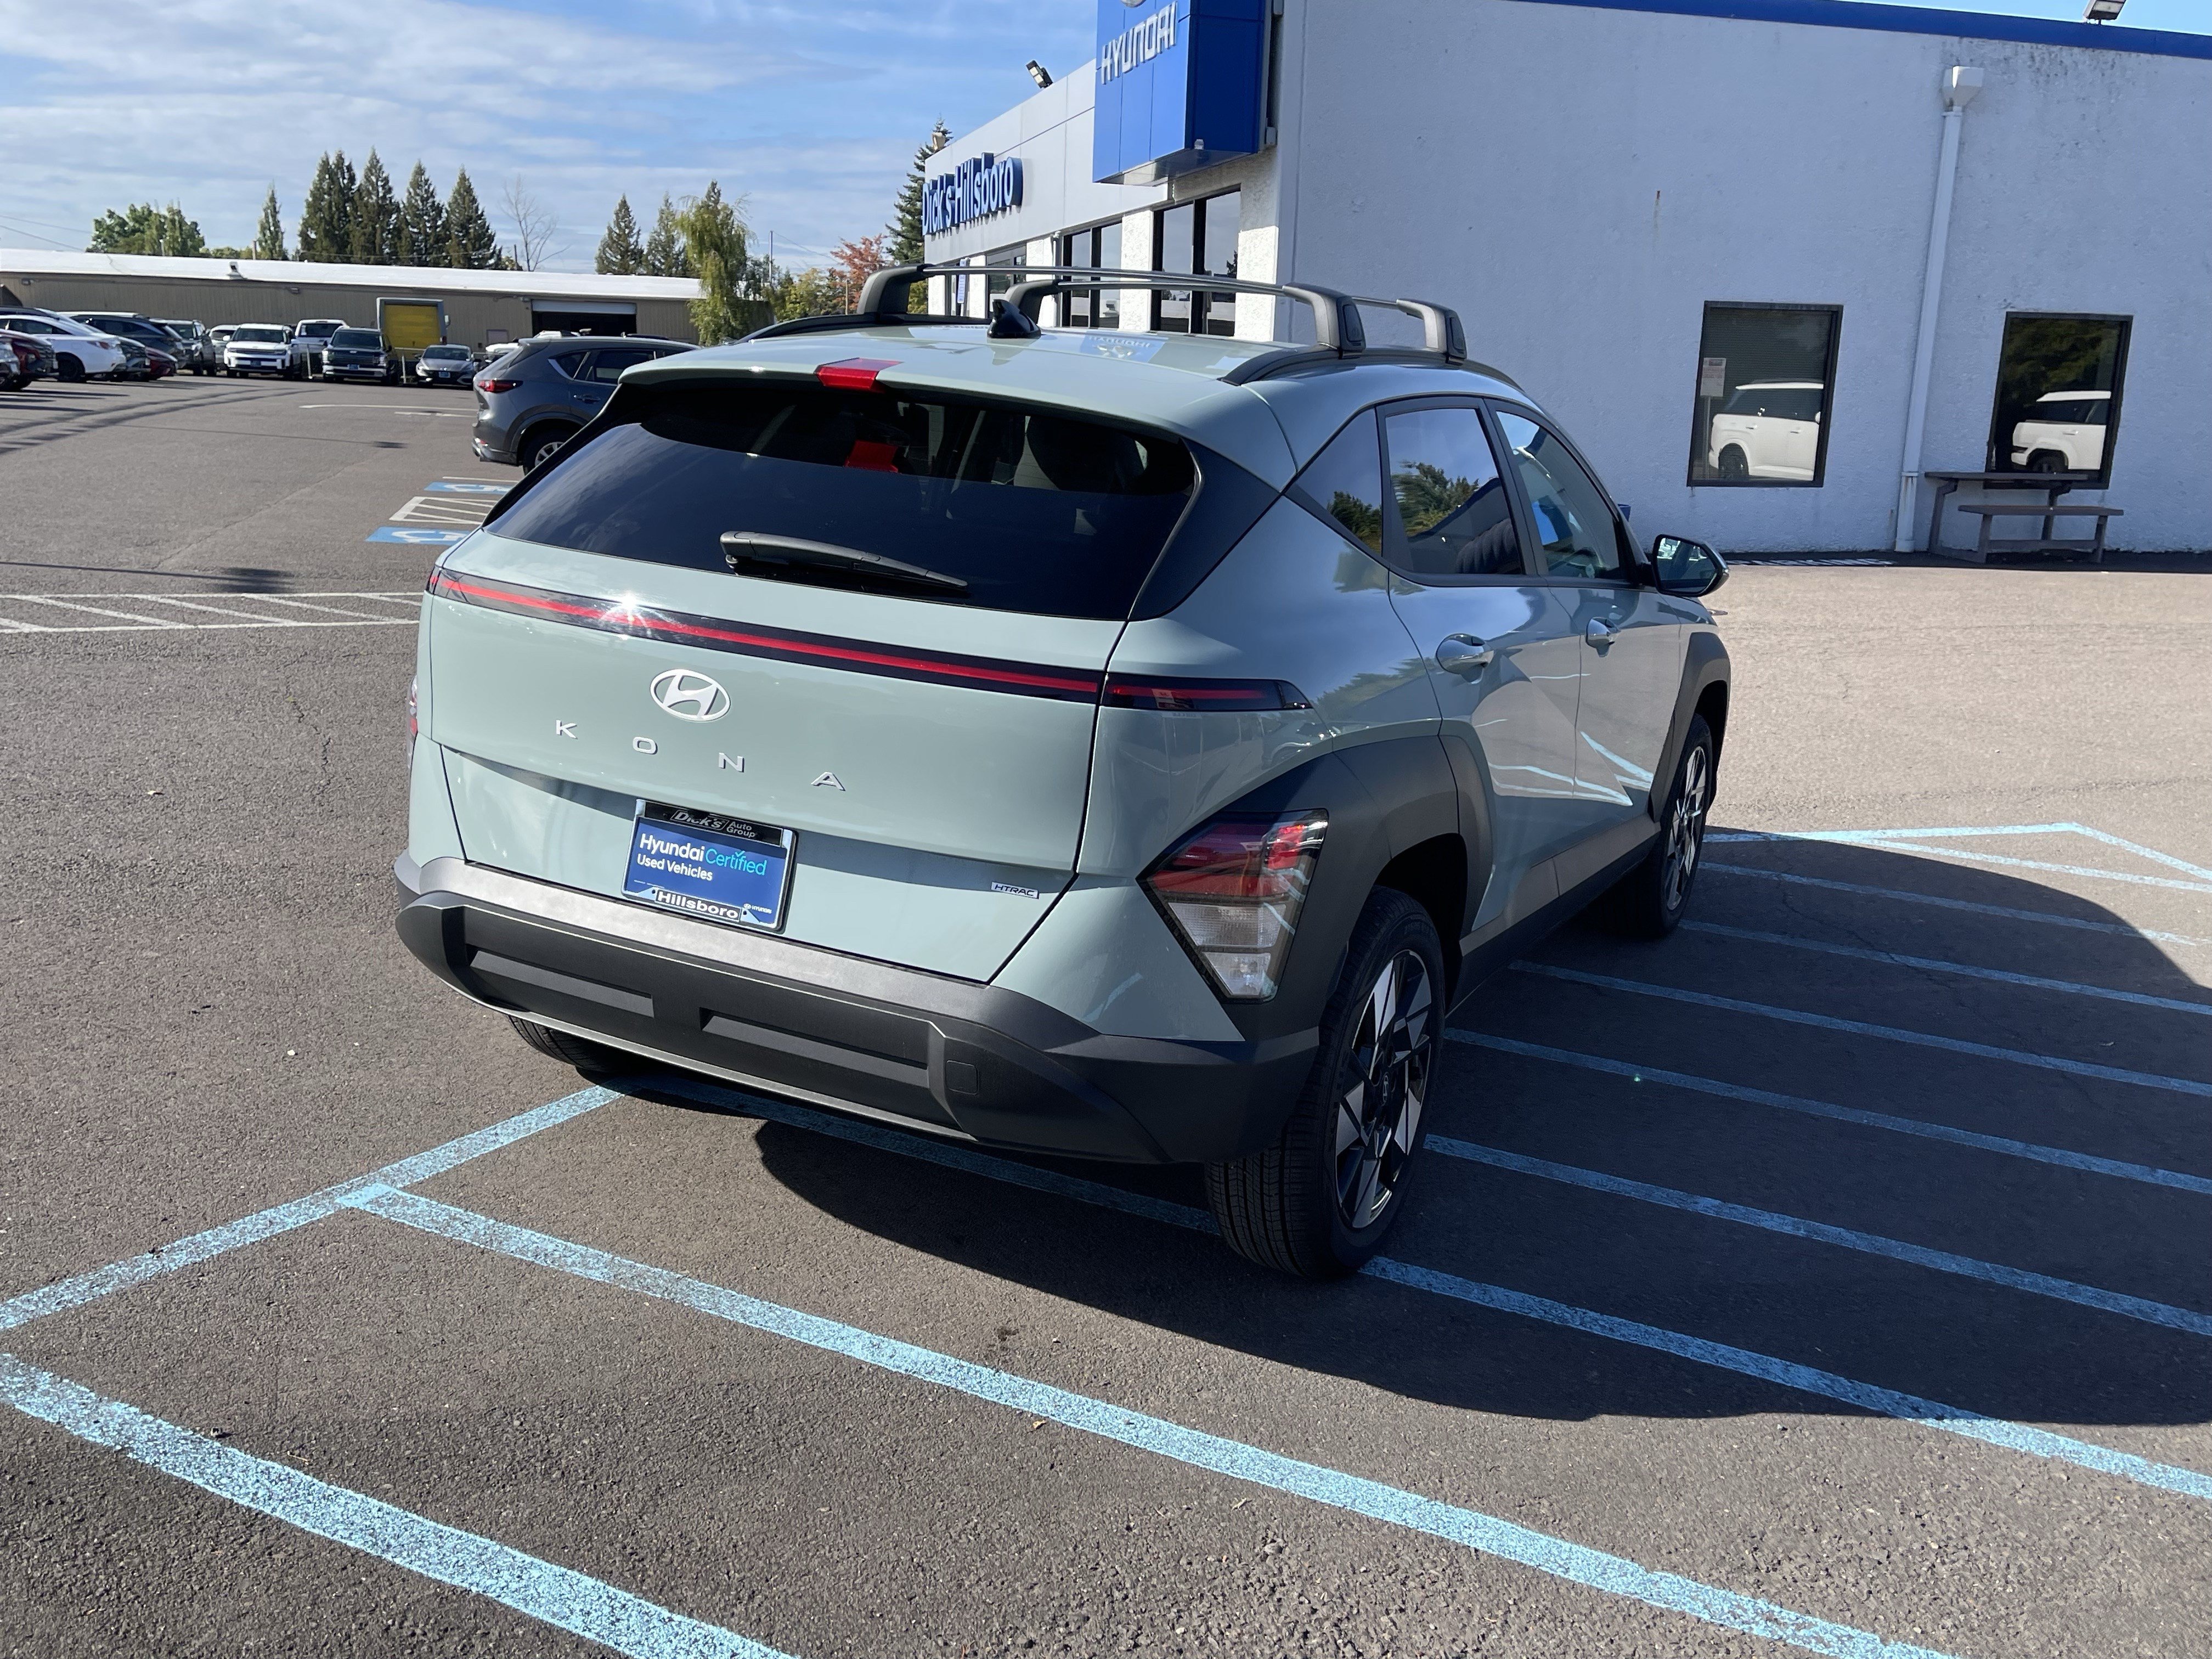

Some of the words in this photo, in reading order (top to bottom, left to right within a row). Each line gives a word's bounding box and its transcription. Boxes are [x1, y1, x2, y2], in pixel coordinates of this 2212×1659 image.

[1101, 0, 1177, 85] HYUNDAI
[955, 151, 1019, 224] Hillsboro
[555, 719, 846, 792] KONA
[726, 826, 756, 838] Group
[729, 821, 752, 831] Auto
[637, 853, 665, 870] Used
[667, 859, 713, 881] Vehicles
[640, 833, 705, 862] Hyundai
[705, 848, 768, 876] Certified
[995, 884, 1035, 896] HTRAC
[658, 891, 738, 918] Hillsboro
